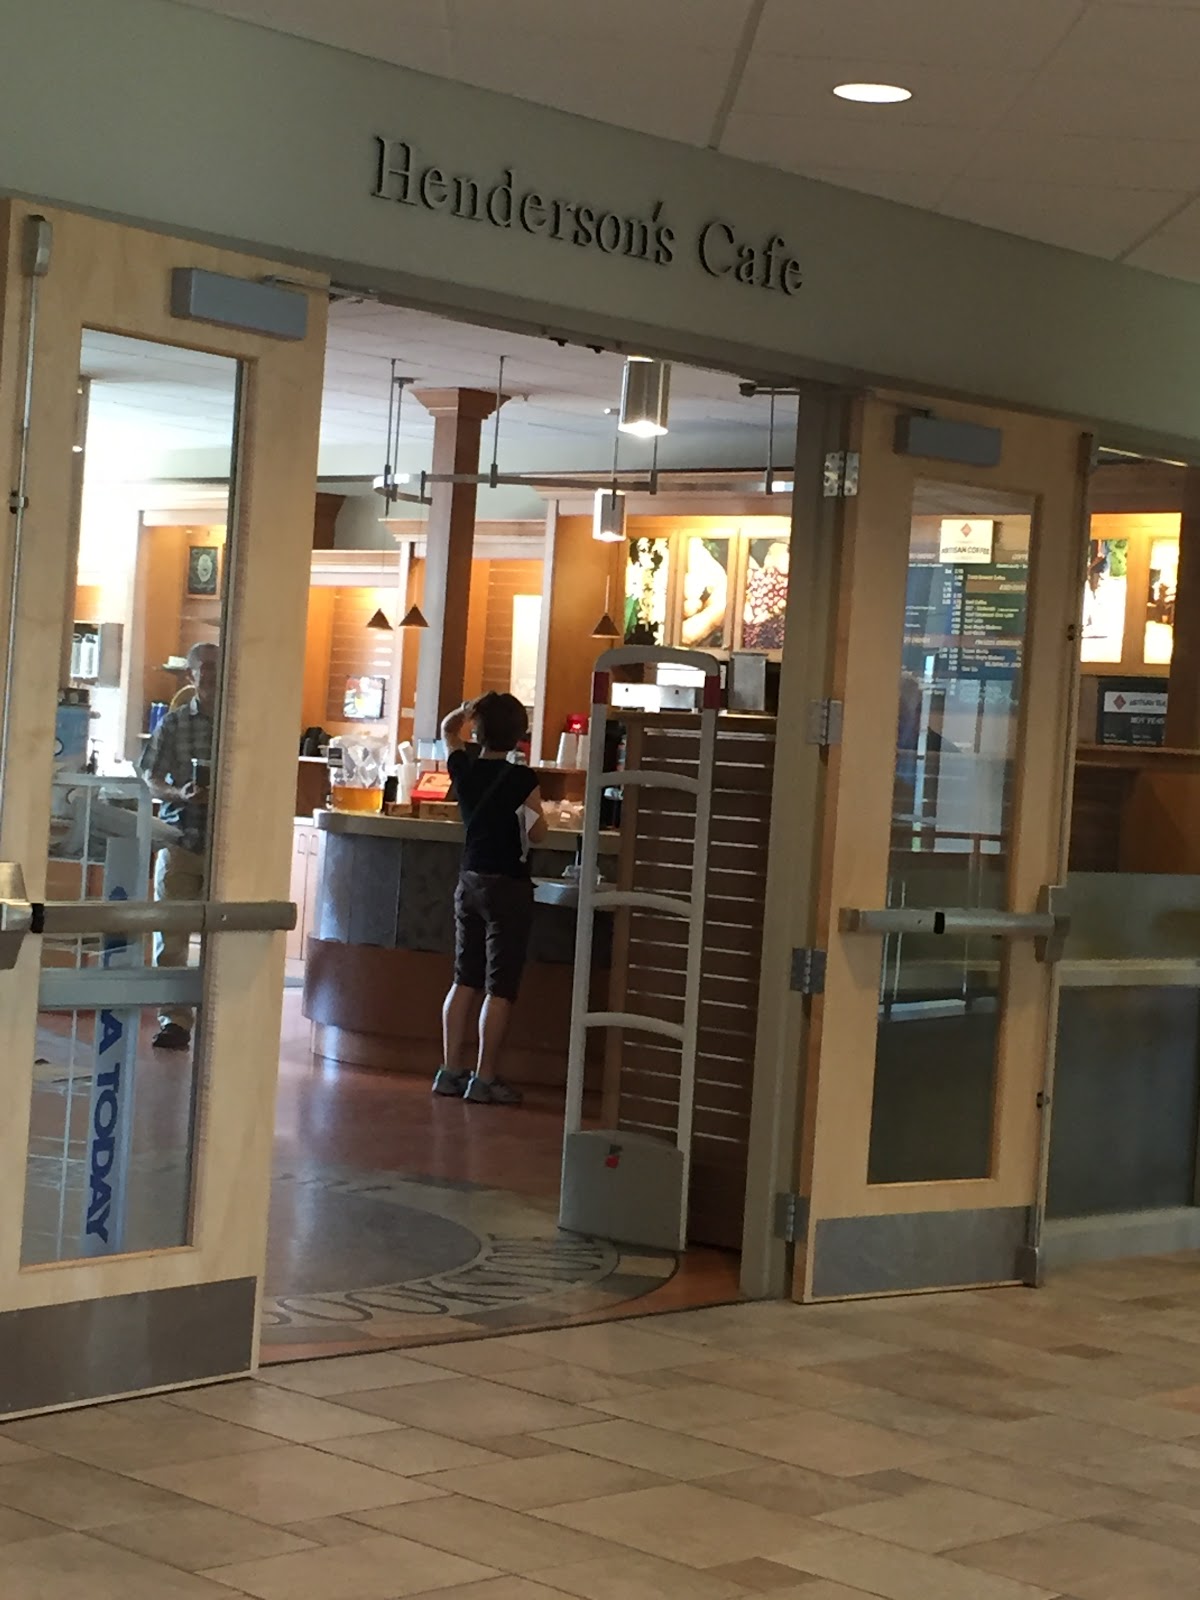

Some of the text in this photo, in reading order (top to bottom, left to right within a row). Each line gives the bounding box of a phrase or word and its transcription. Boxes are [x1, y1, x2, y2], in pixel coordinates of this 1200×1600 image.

[370, 135, 804, 296] Henderson's Cafe
[86, 1063, 121, 1244] TODAY
